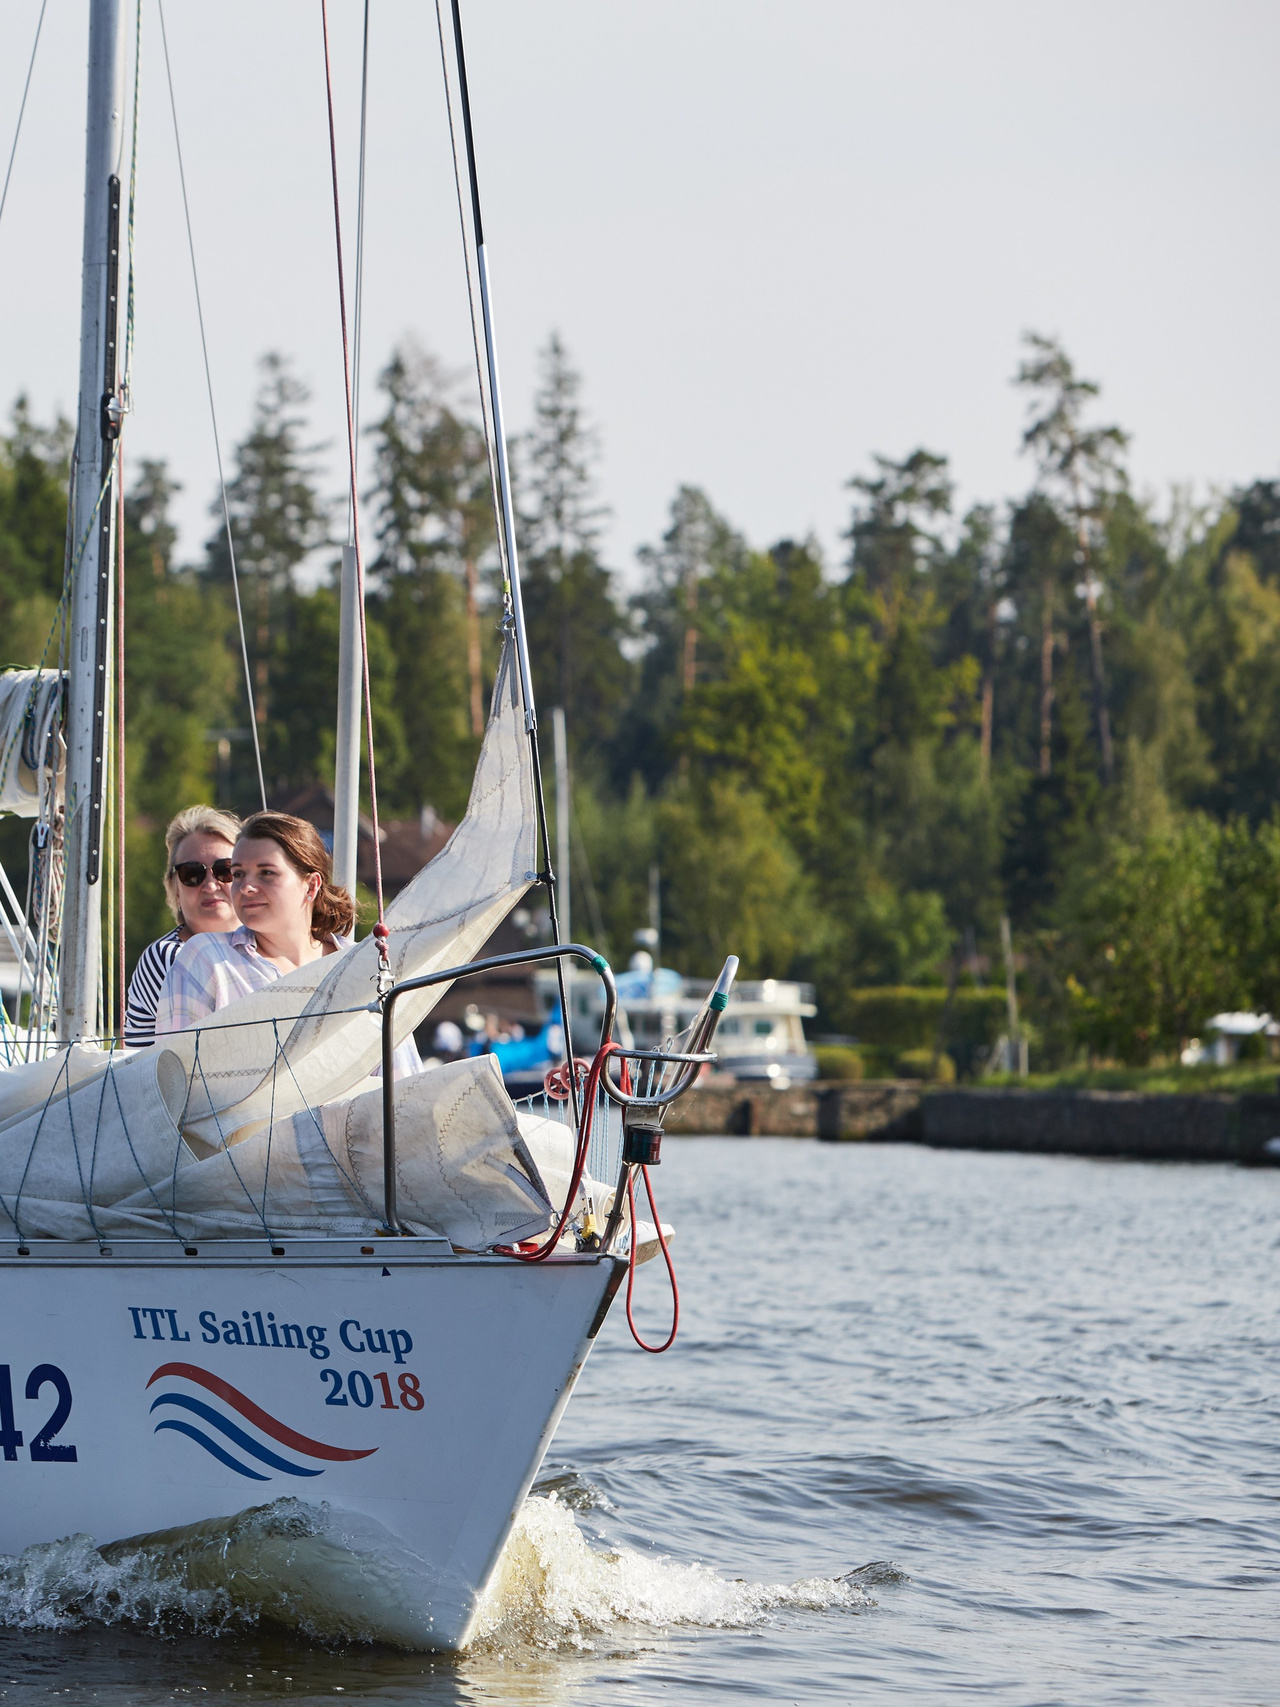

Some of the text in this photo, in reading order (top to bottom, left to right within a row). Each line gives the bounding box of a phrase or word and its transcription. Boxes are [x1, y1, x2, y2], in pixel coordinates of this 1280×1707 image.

[127, 1306, 414, 1365] ITL Sailing Cup
[319, 1368, 426, 1412] 2018
